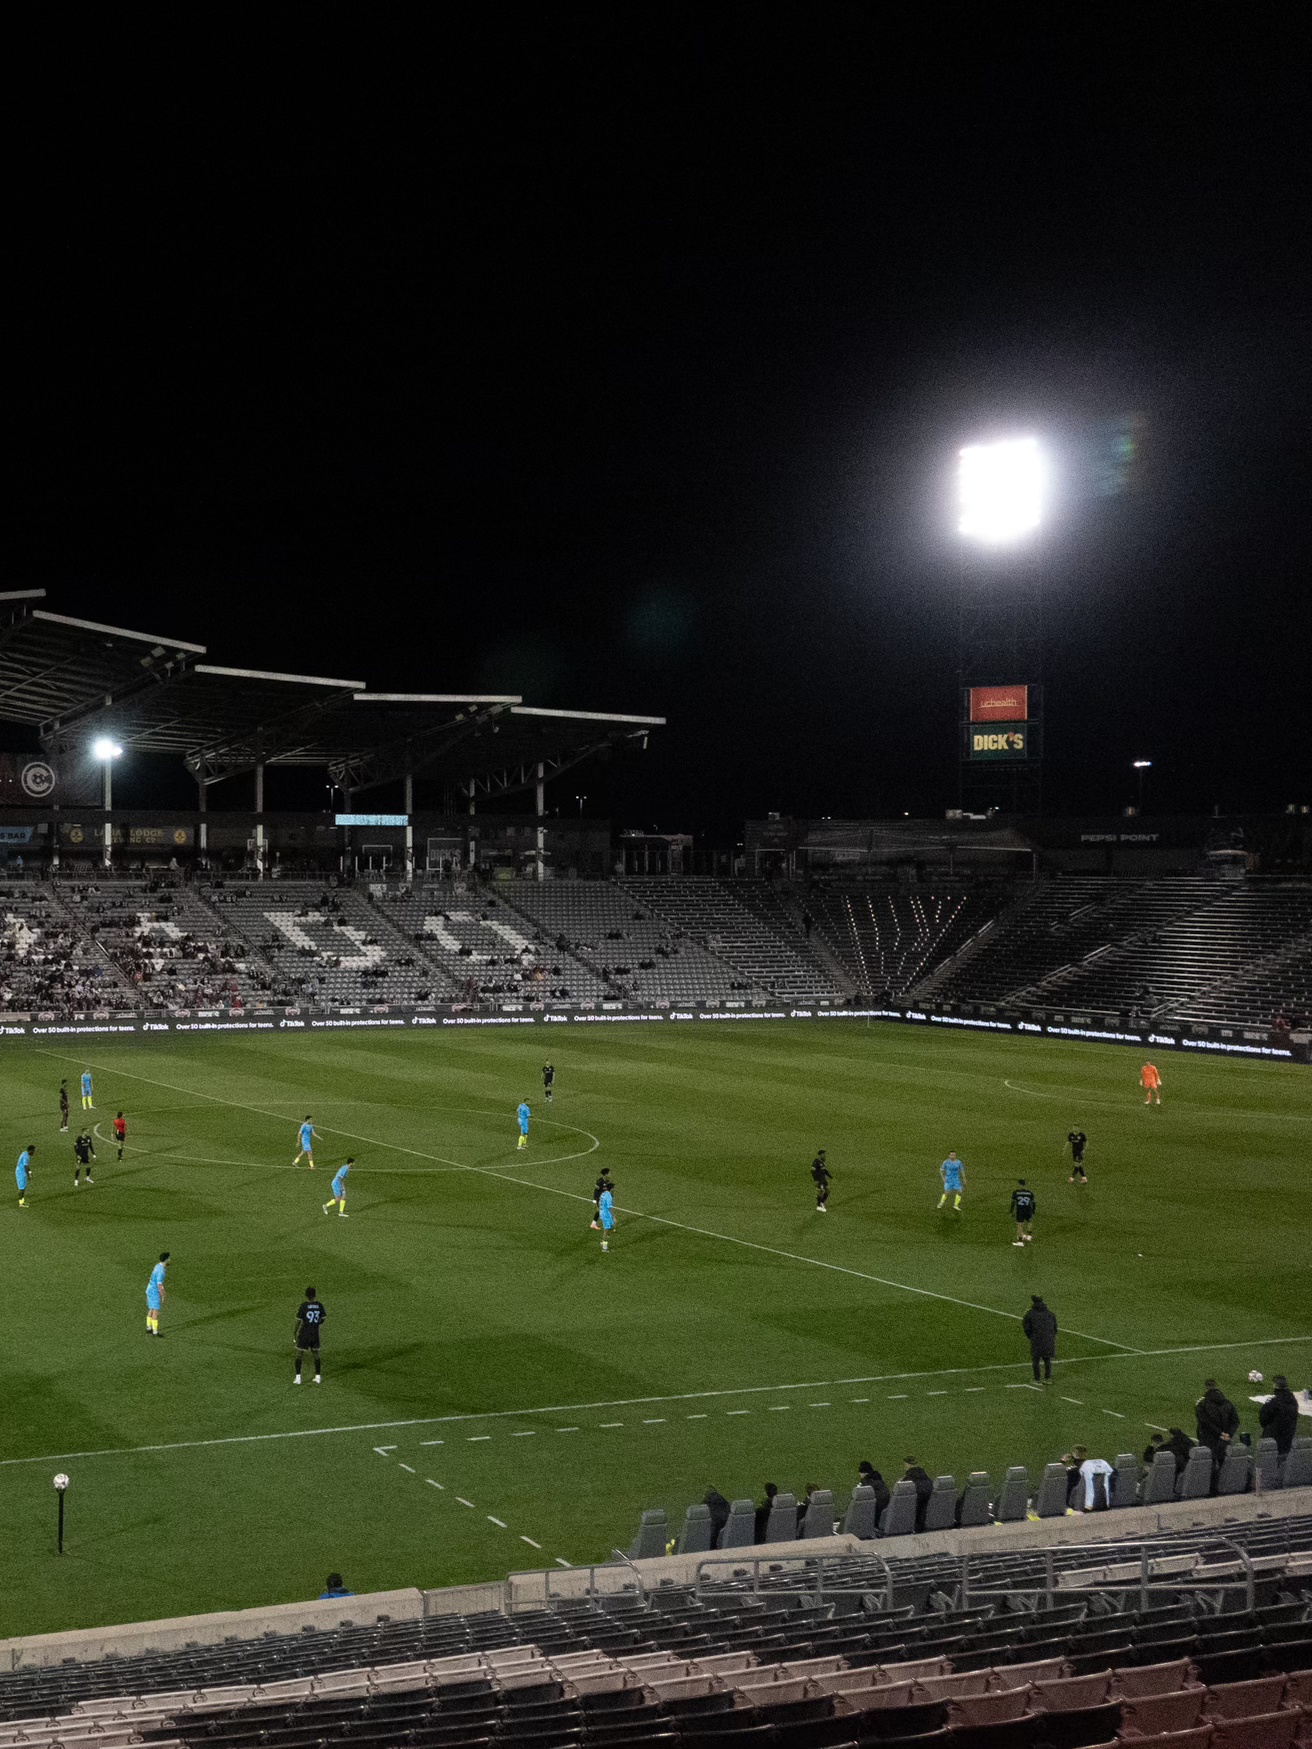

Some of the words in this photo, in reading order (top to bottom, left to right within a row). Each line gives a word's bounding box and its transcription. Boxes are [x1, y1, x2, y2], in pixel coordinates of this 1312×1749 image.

[973, 732, 1024, 751] DICK'S
[1080, 834, 1117, 842] PEPSI
[1120, 834, 1159, 842] POINT
[218, 1022, 248, 1030] protections
[287, 1020, 304, 1028] TikTok
[351, 1018, 380, 1026] protections
[6, 1026, 24, 1034] TikTok
[77, 1026, 109, 1034] protections
[1183, 1038, 1197, 1046] Over
[1207, 1042, 1226, 1050] built-in
[1227, 1044, 1261, 1054] protections
[1272, 1048, 1291, 1056] teens.
